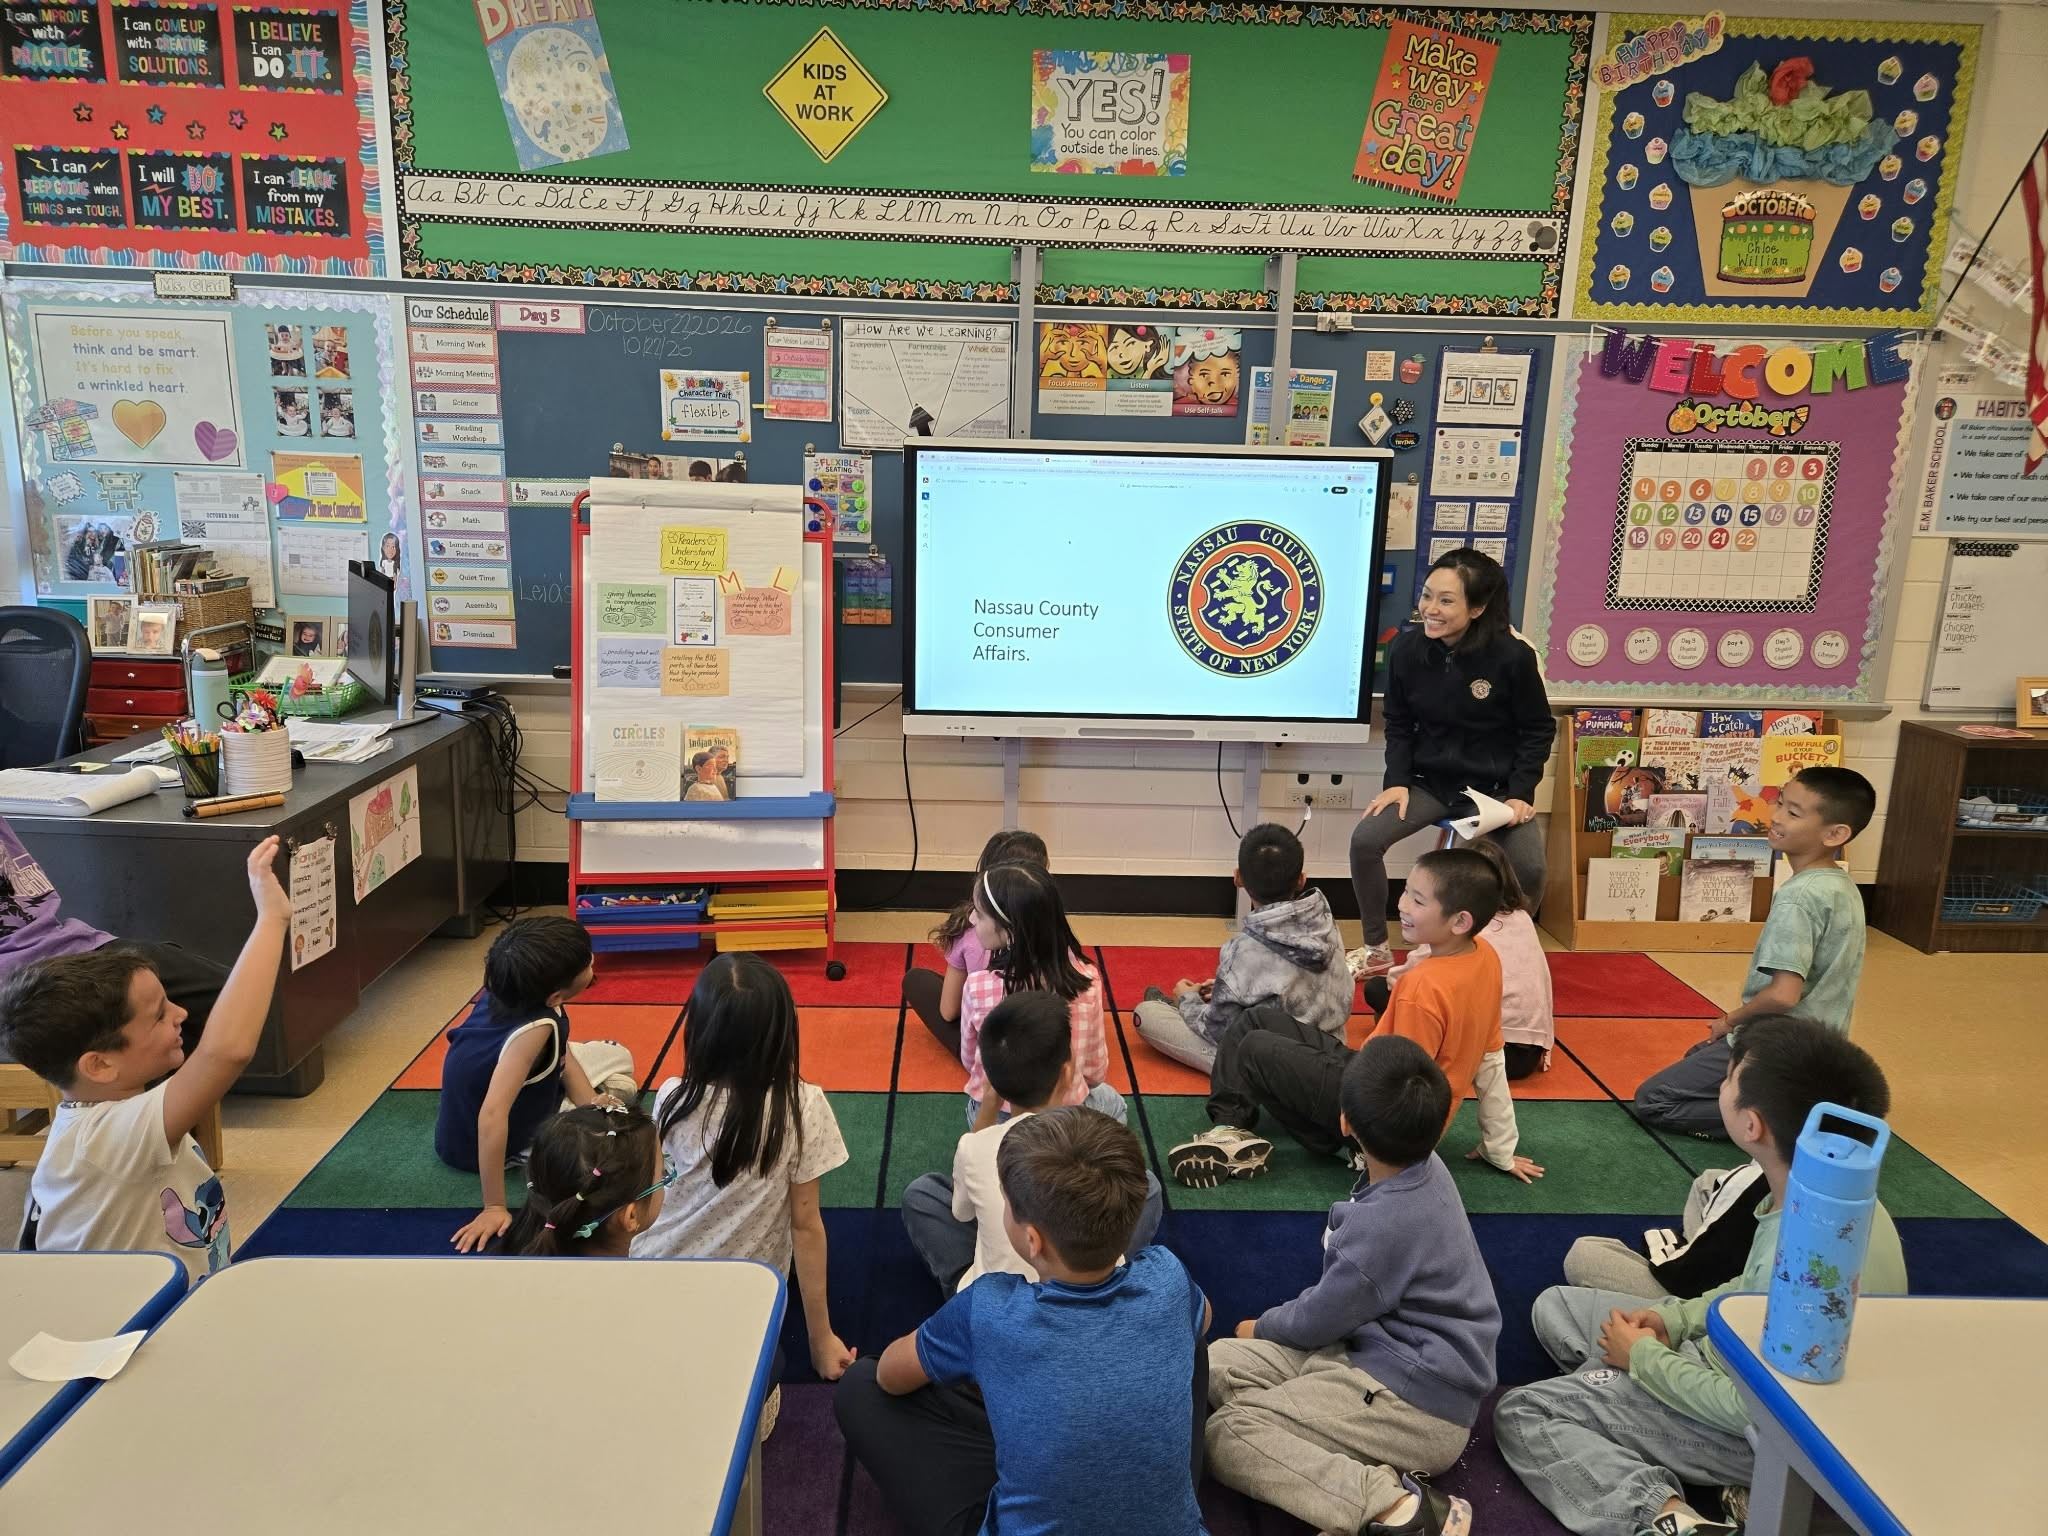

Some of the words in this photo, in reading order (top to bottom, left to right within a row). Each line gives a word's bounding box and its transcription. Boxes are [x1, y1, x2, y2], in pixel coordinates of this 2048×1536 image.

[5, 9, 12, 21] I
[15, 12, 36, 22] can
[40, 9, 89, 24] IMPROVE
[32, 25, 64, 39] with
[124, 18, 129, 30] I
[132, 21, 151, 31] can
[155, 19, 188, 33] COME
[191, 19, 205, 33] UP
[251, 22, 256, 39] I
[260, 21, 321, 42] BELIEVE
[127, 37, 151, 49] with
[156, 37, 206, 52] CREATIVE
[252, 42, 258, 54] I
[261, 45, 281, 56] can
[1617, 26, 1683, 64] HAPPY
[11, 46, 93, 68] PRACTICE.
[1403, 35, 1477, 76] Make
[129, 56, 211, 75] SOLUTIONS.
[254, 57, 284, 78] DO
[292, 50, 332, 80] IT.
[802, 63, 846, 80] KIDS
[814, 85, 836, 100] AT
[1408, 67, 1470, 107] way
[1057, 68, 1165, 125] YES!
[1408, 92, 1432, 109] for
[1434, 101, 1445, 112] a
[796, 104, 853, 122] WORK
[1061, 123, 1084, 138] You
[1089, 129, 1115, 140] can
[1120, 126, 1156, 141] color
[1373, 99, 1473, 151] Great
[1061, 141, 1104, 154] outside
[1109, 140, 1127, 154] the
[1132, 142, 1160, 155] lines.
[51, 159, 59, 172] I
[63, 163, 87, 173] can
[1380, 133, 1463, 189] day!
[139, 166, 146, 182] I
[152, 168, 174, 182] will
[186, 166, 216, 192] DO
[254, 172, 260, 184] I
[264, 174, 284, 186] can
[289, 169, 332, 188] LEARN
[94, 183, 118, 194] when
[268, 190, 299, 203] from
[305, 193, 323, 206] my
[27, 203, 63, 215] THINGS
[85, 205, 122, 216] TOUGH.
[142, 196, 171, 217] MY
[178, 197, 229, 220] BEST.
[1736, 199, 1806, 217] OCTOBER
[256, 206, 338, 228] MISTAKES.
[1748, 242, 1779, 254] Chloe
[1738, 254, 1788, 266] William
[412, 305, 433, 318] Our
[437, 306, 489, 321] Schedule
[520, 308, 547, 324] Day
[551, 308, 560, 322] 5
[588, 308, 671, 333] October
[71, 325, 112, 336] Before
[118, 329, 139, 340] you
[73, 343, 105, 354] think
[111, 345, 132, 356] and
[139, 346, 153, 356] be
[159, 348, 199, 358] smart.
[436, 340, 465, 349] Morning
[468, 340, 486, 348] Work
[102, 362, 131, 374] hard
[137, 365, 150, 374] to
[155, 364, 173, 375] fix
[1601, 327, 1910, 399] WELCOME
[436, 370, 464, 378] Morning
[466, 371, 494, 379] Meeting
[1300, 374, 1327, 385] Danger
[90, 380, 143, 391] wrinkled
[149, 382, 188, 393] heart.
[716, 391, 731, 399] Trait
[682, 404, 729, 418] flexible
[1694, 402, 1795, 428] October
[1976, 400, 2026, 417] HABITS
[455, 425, 482, 433] Reading
[1930, 422, 1947, 469] SCHOOL
[462, 461, 478, 469] Gym
[1781, 462, 1788, 473] 2
[1808, 464, 1816, 474] 3
[1696, 485, 1704, 496] 6
[1924, 471, 1938, 507] BAKER
[1662, 508, 1674, 519] 12
[1716, 509, 1729, 520] 14
[1743, 510, 1757, 521] 15
[1920, 510, 1932, 531] E.M.
[679, 534, 706, 545] Readers
[1712, 533, 1726, 544] 21
[1739, 535, 1754, 545] 22
[672, 547, 716, 556] Understand
[1177, 527, 1238, 585] NASSAU
[1260, 528, 1317, 588] COUNTY
[678, 557, 699, 570] Story
[973, 599, 1034, 617] Nassau
[1039, 600, 1098, 620] County
[973, 622, 1059, 639] Consumer
[1174, 606, 1206, 655] STATE
[1209, 654, 1232, 670] OF
[1240, 652, 1279, 672] NEW
[1282, 609, 1317, 653] YORK
[973, 644, 1030, 661] Affairs.
[1711, 713, 1732, 724] How
[613, 727, 665, 739] CIRCLES
[1655, 726, 1688, 735] ACORN
[1719, 720, 1744, 733] Catch
[1776, 753, 1828, 763] BUCKET?
[1623, 834, 1669, 845] Everybody
[1608, 889, 1645, 898] IDEA?
